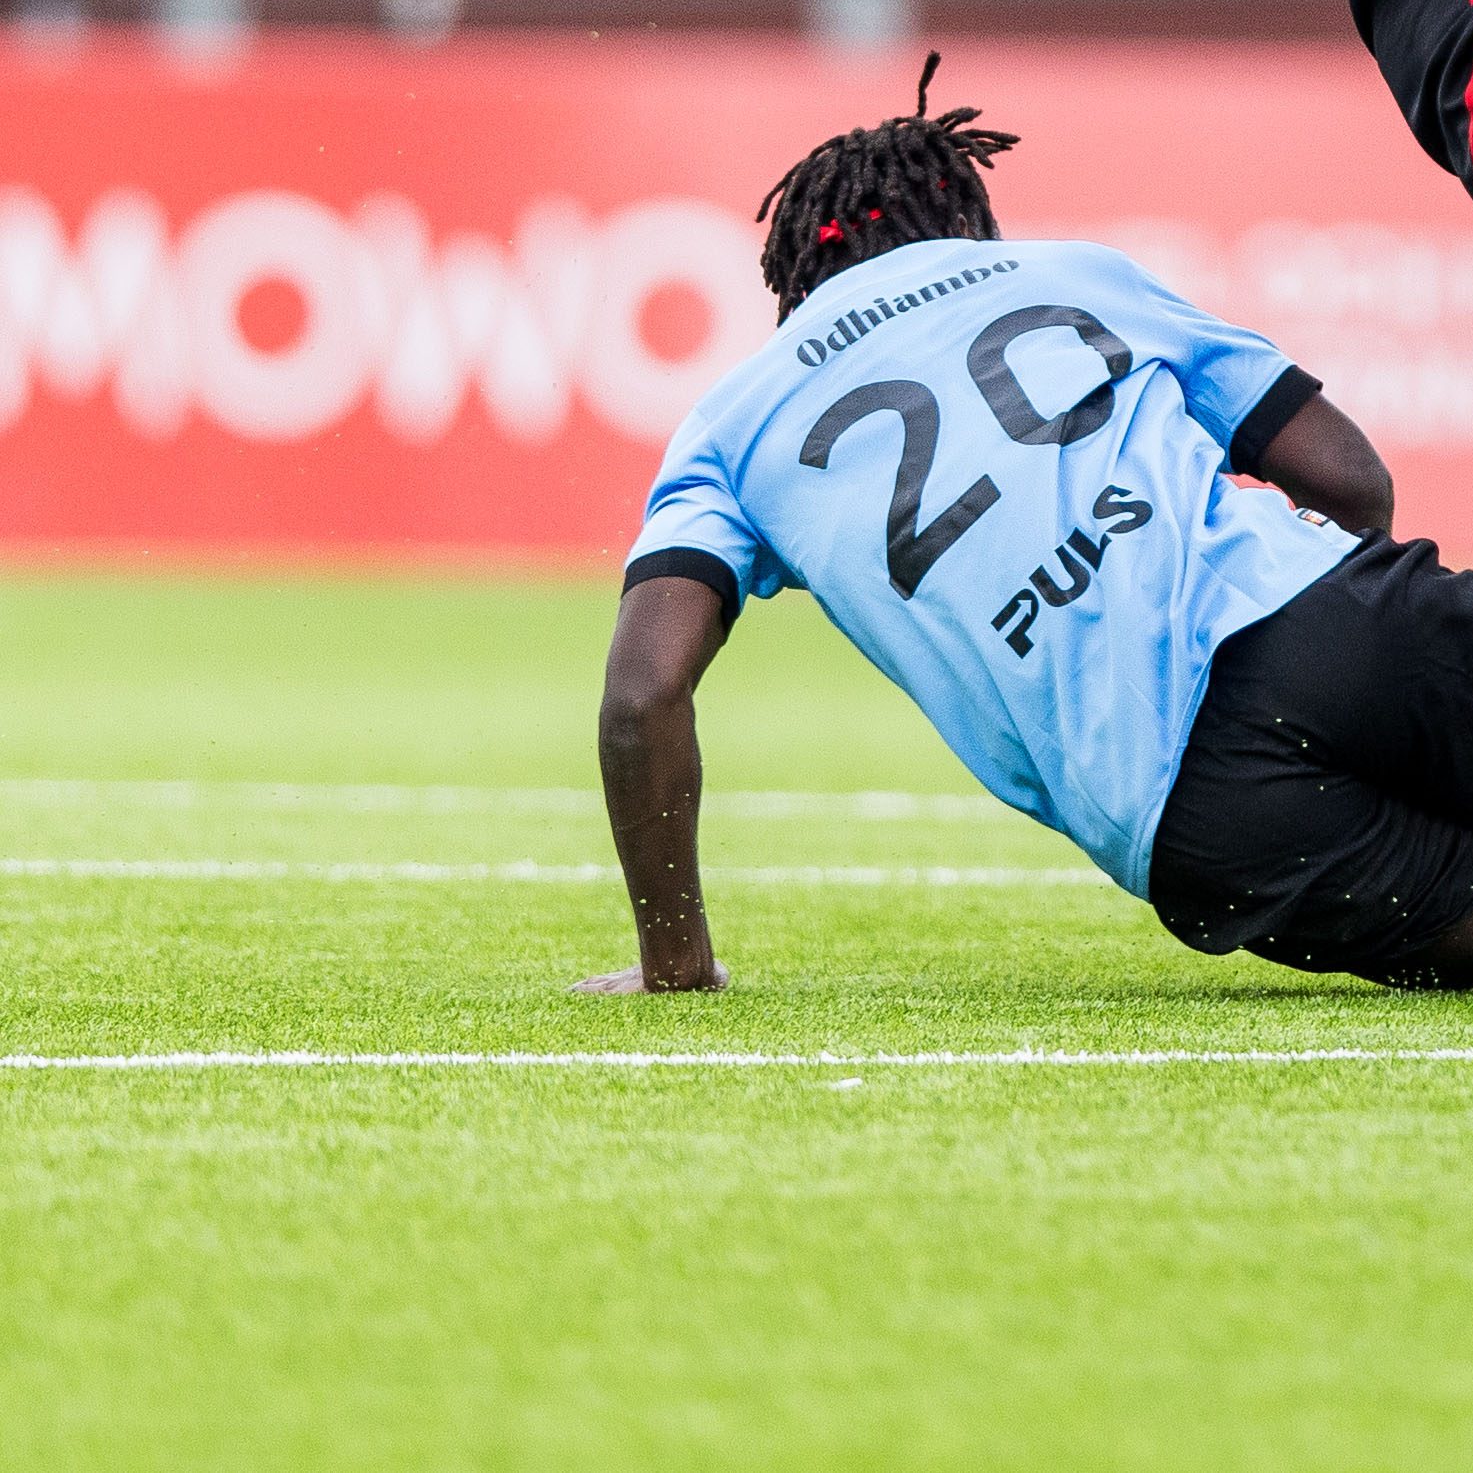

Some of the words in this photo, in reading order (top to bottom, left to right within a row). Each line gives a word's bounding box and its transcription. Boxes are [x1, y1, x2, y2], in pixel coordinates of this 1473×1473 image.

[796, 257, 1020, 368] Odhiambo
[798, 303, 1134, 602] 20
[990, 484, 1154, 659] PULS
